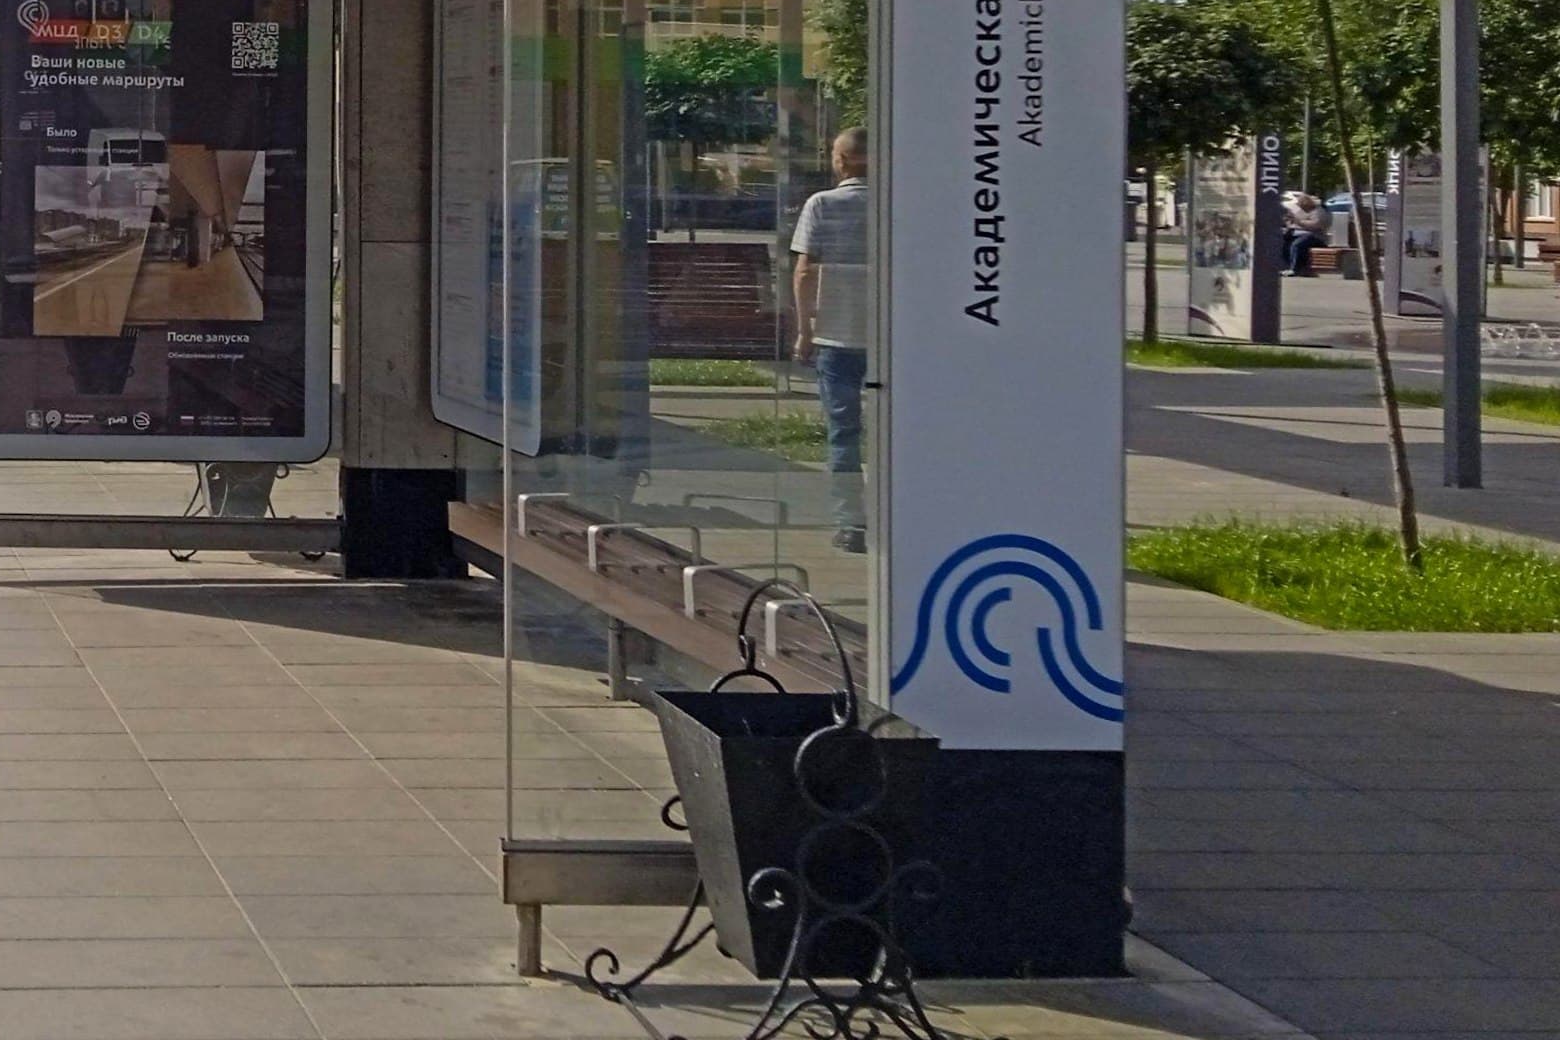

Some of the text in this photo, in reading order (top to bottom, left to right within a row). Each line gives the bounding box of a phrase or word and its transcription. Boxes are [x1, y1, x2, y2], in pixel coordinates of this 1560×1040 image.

[38, 24, 78, 38] МЦД
[96, 24, 122, 39] D3
[31, 54, 126, 69] Ваши новые
[30, 71, 185, 89] удобные маршруты
[46, 126, 78, 137] Было
[1261, 136, 1280, 194] ОИЦК
[167, 331, 250, 345] После запуска
